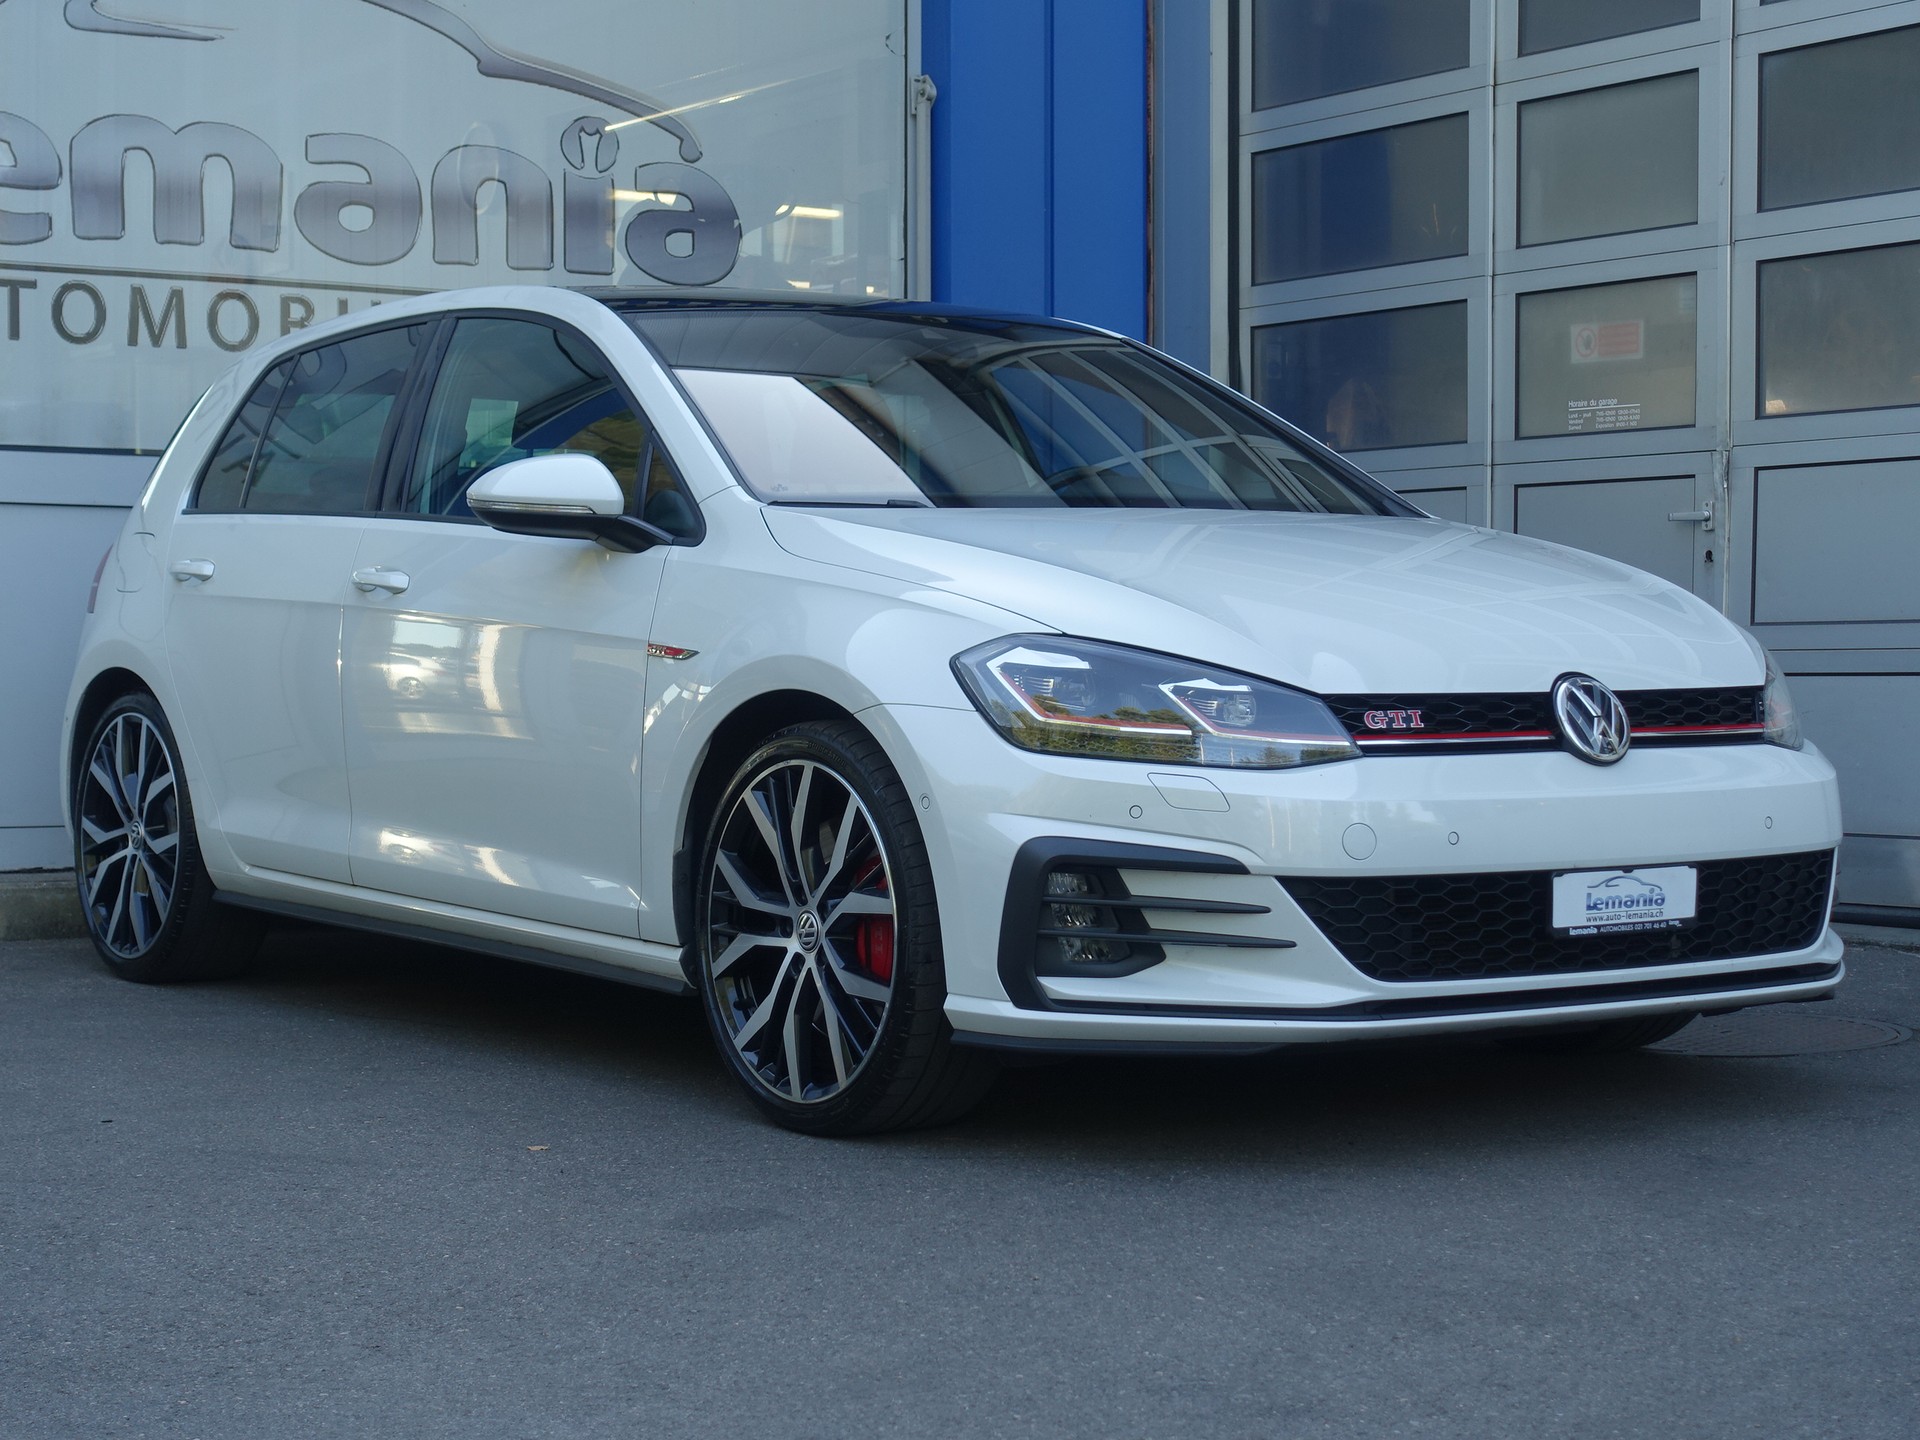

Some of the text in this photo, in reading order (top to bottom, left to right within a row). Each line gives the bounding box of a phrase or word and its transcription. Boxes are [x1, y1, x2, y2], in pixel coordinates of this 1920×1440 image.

[1568, 400, 1588, 408] Horaire
[1598, 398, 1618, 407] garage
[1363, 709, 1424, 729] GTI
[1586, 910, 1664, 923] www.auto-lemania.ch
[1600, 924, 1633, 933] AUTOMOBILES
